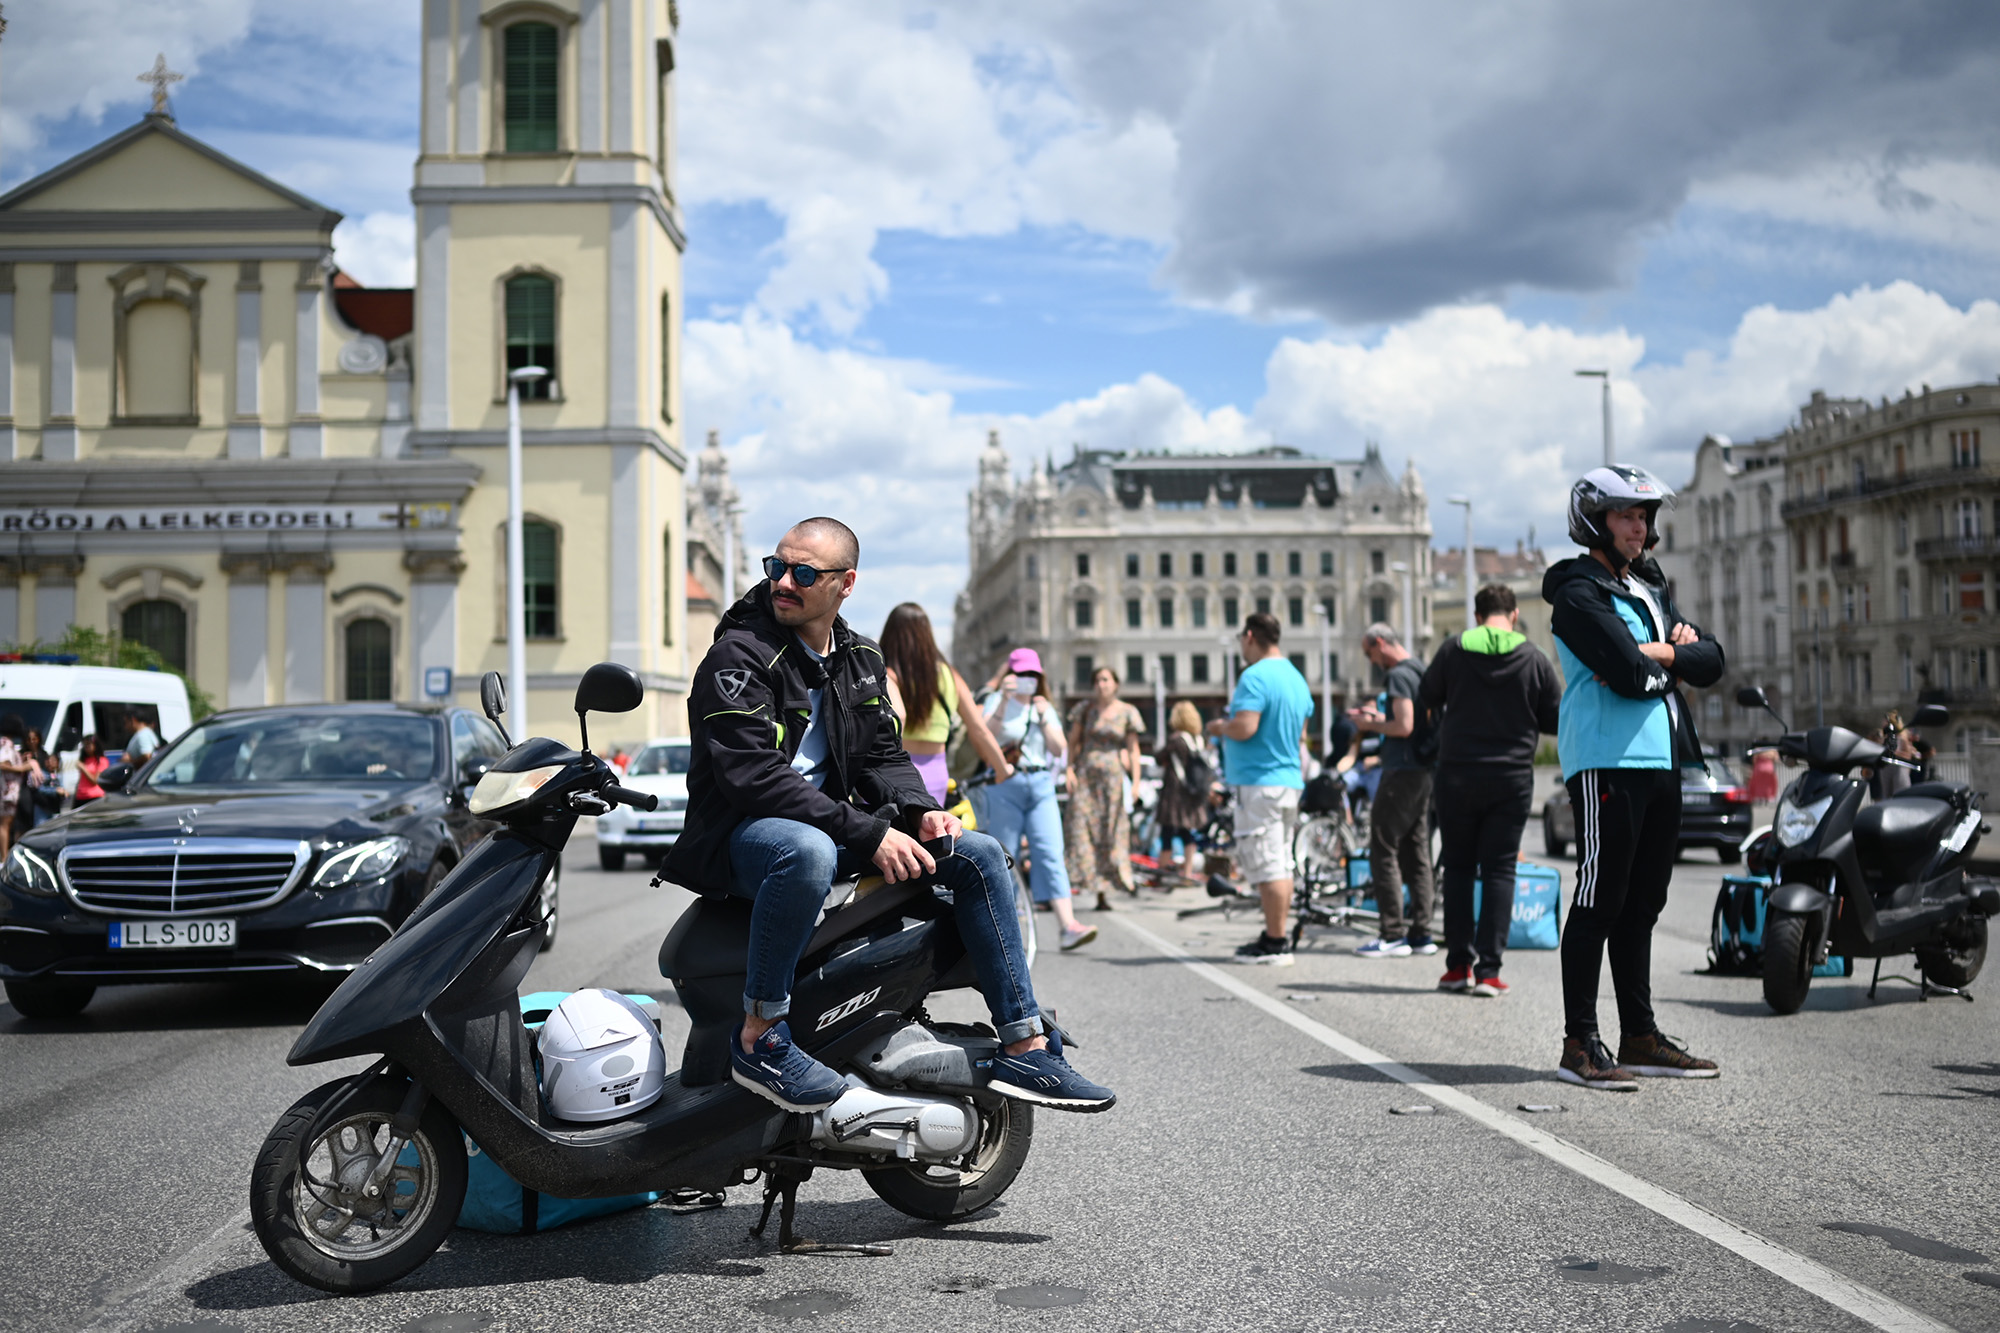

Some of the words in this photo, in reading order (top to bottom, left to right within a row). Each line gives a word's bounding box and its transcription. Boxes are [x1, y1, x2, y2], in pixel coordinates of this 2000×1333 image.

[105, 514, 127, 530] A
[139, 511, 353, 529] LELKEDDEL!
[126, 922, 230, 944] LLS-003
[608, 1086, 634, 1096] BREAKER
[928, 1123, 964, 1133] HONDA
